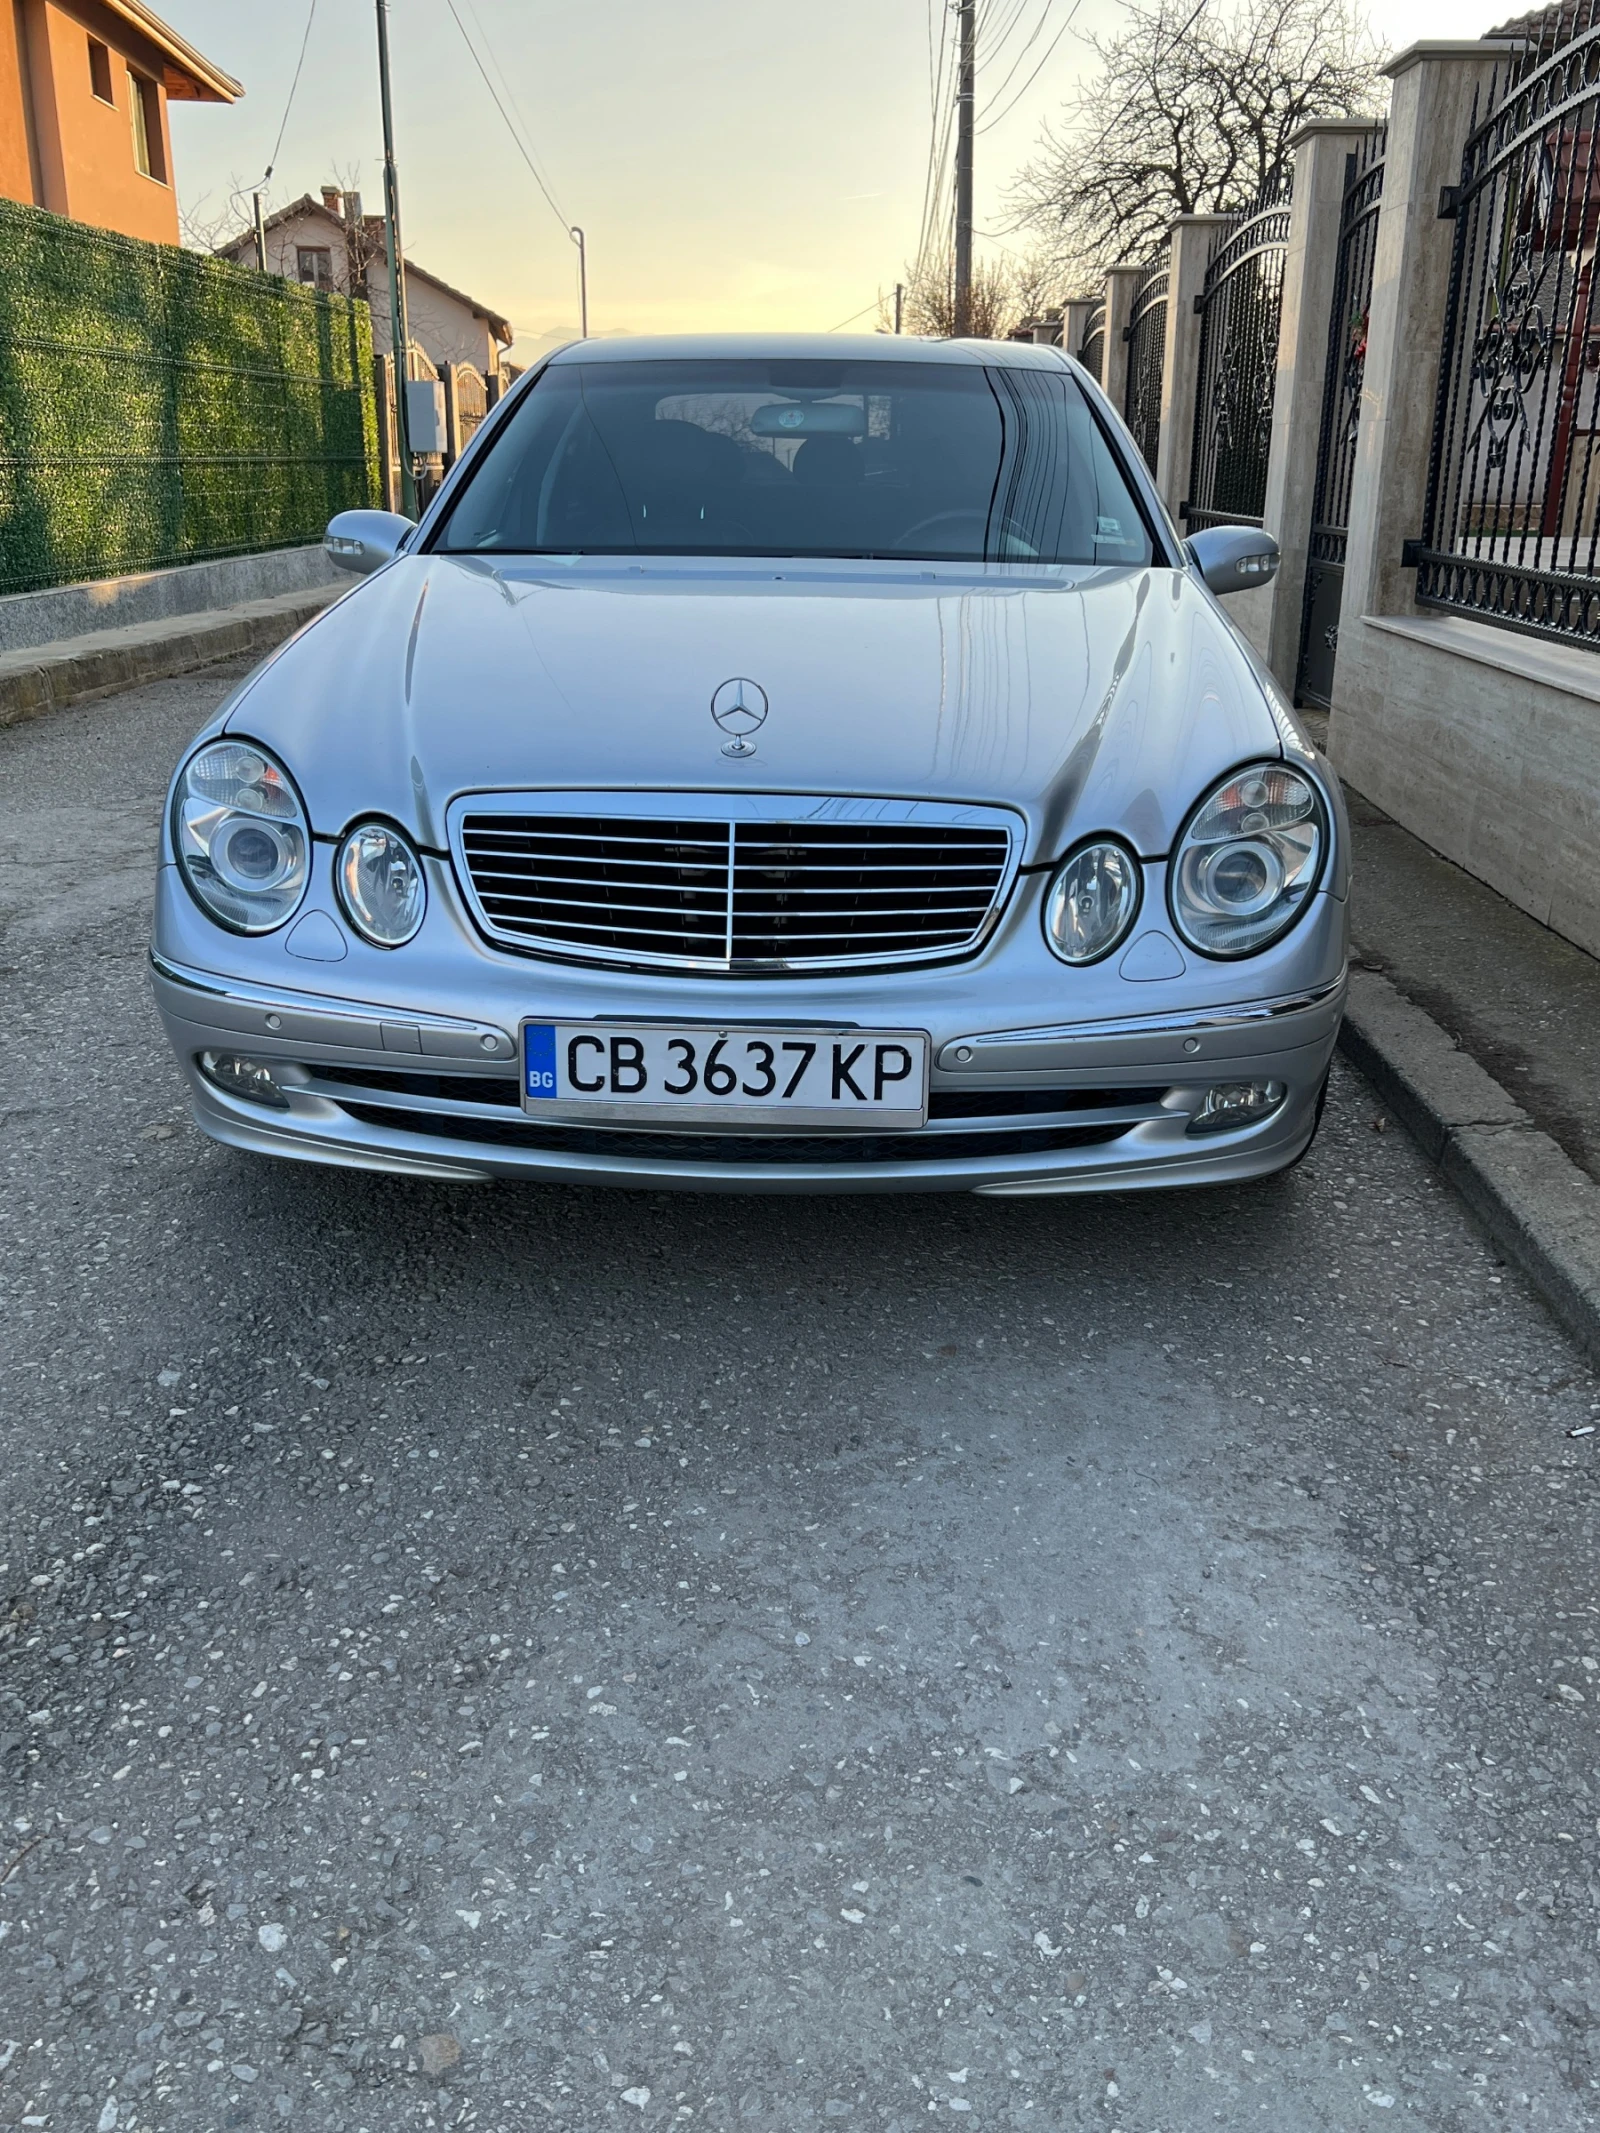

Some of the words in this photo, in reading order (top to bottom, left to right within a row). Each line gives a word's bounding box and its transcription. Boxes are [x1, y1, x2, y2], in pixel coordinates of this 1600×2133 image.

[529, 1070, 554, 1089] BG
[567, 1035, 648, 1094] CB
[664, 1038, 817, 1098] 3637
[831, 1043, 912, 1101] KP
